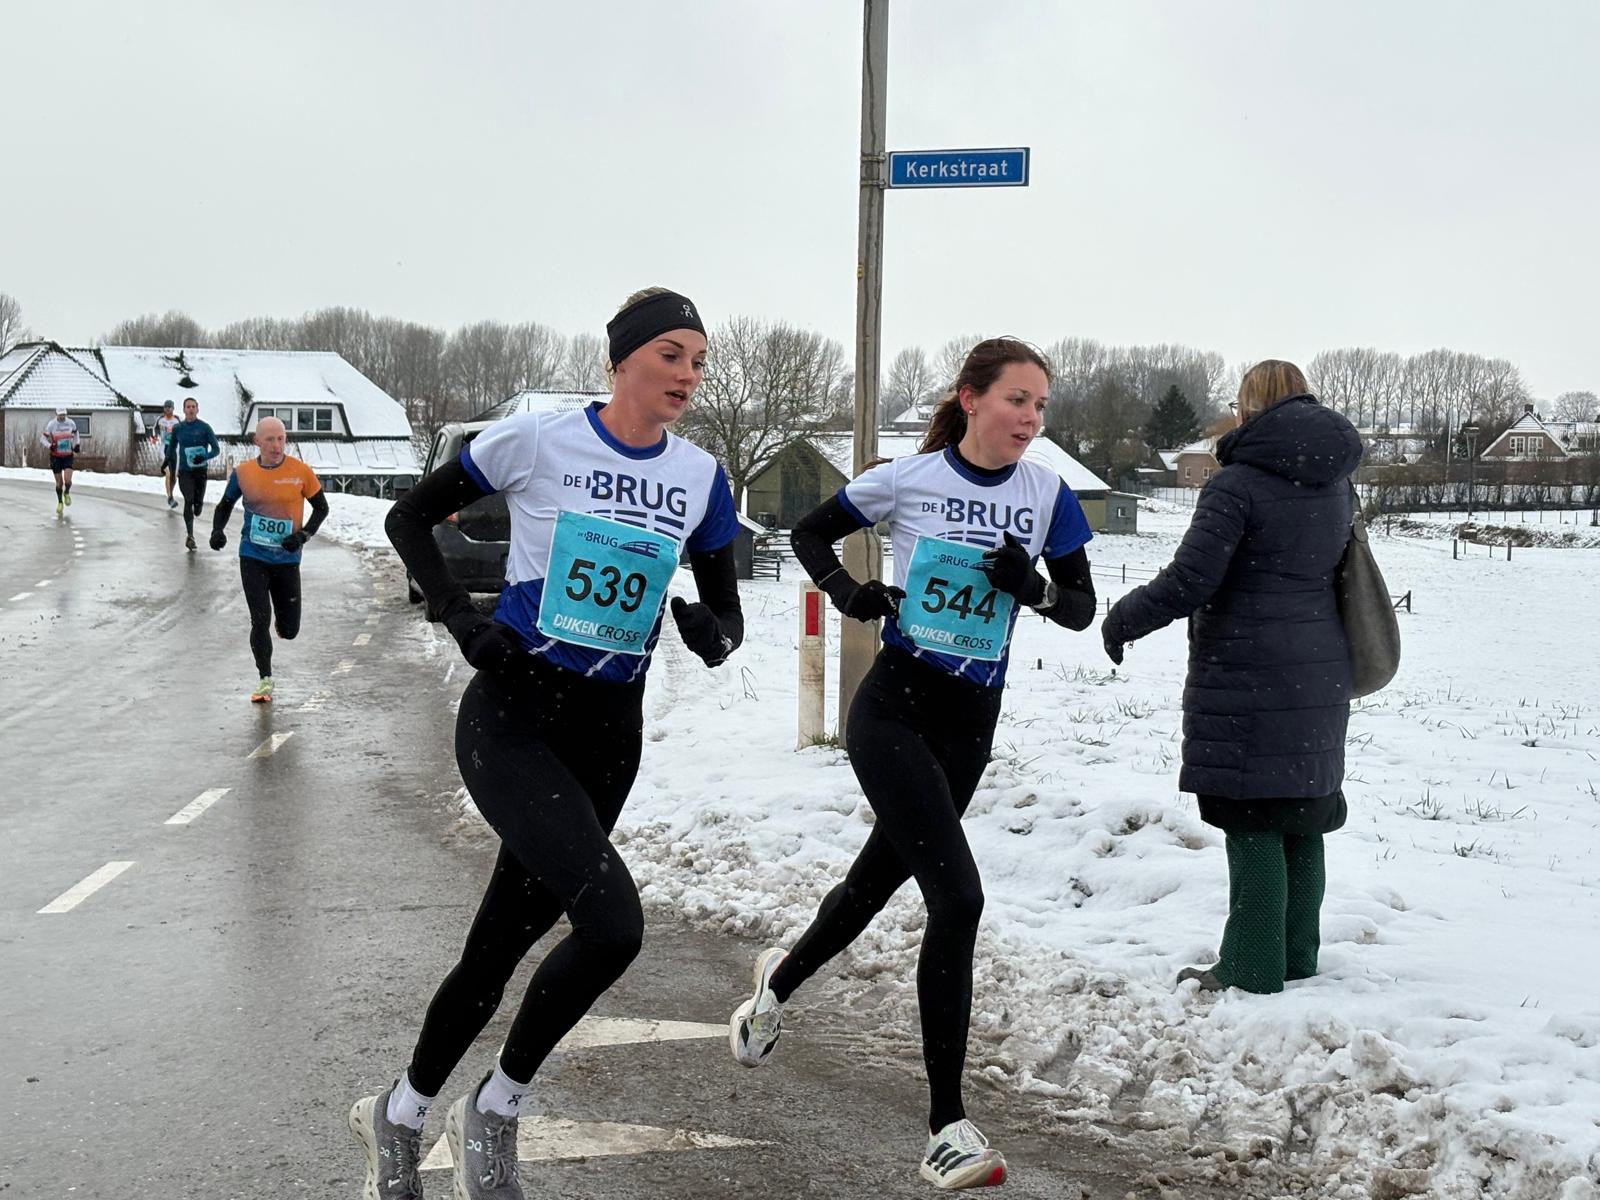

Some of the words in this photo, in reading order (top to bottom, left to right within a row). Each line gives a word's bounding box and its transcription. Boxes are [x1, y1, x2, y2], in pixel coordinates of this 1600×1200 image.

[906, 159, 1008, 178] Kerkstraat
[563, 473, 582, 488] DE
[586, 469, 687, 518] BRUG
[257, 518, 286, 535] 580
[921, 501, 938, 514] DE
[941, 497, 1034, 535] BRUG
[585, 531, 619, 548] BRUG
[939, 553, 969, 568] BRUG
[565, 558, 648, 613] 539
[921, 576, 997, 625] 544
